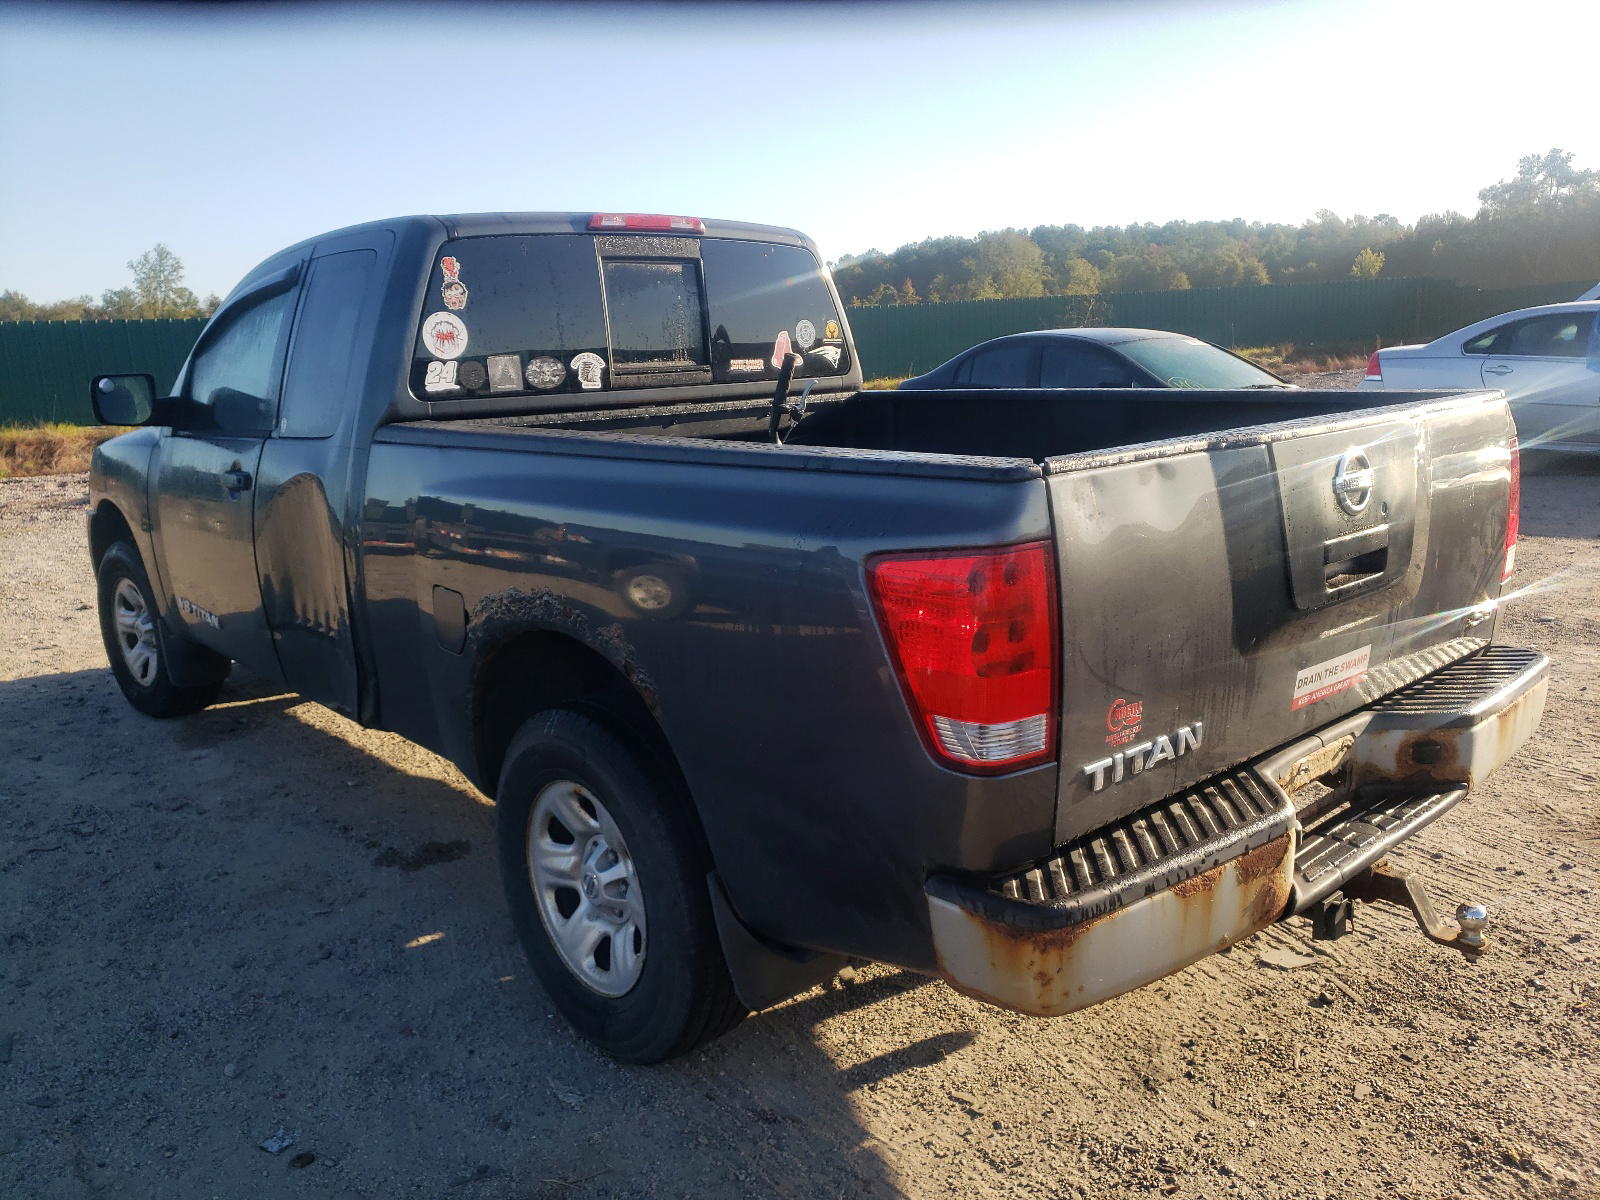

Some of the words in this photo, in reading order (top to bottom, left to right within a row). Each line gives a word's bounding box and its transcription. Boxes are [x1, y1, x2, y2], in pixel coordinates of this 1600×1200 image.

[427, 361, 455, 384] 24
[1297, 671, 1322, 689] DRAIN
[1324, 665, 1339, 679] THE
[1340, 654, 1368, 673] SWAMP
[1311, 686, 1333, 700] AMERICA
[1333, 680, 1350, 692] GREAT
[1083, 721, 1203, 792] TITAN
